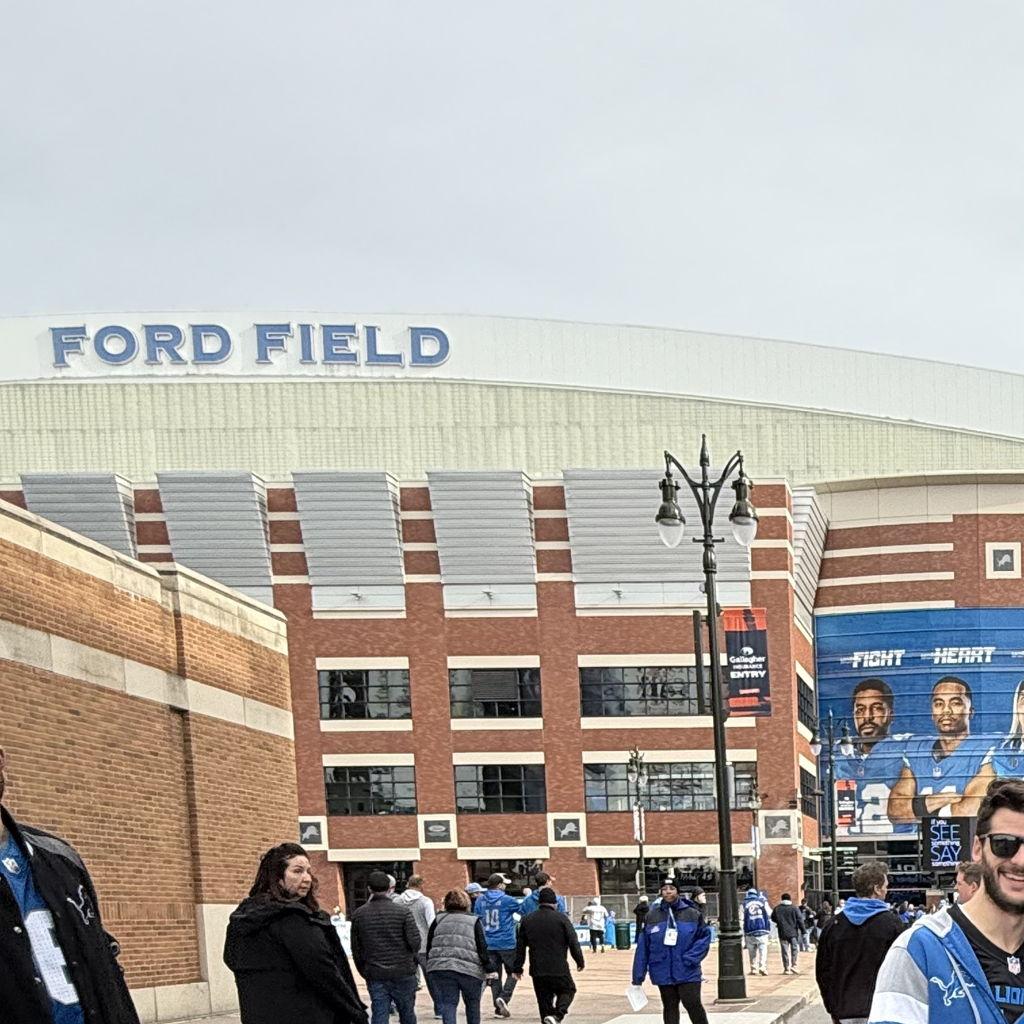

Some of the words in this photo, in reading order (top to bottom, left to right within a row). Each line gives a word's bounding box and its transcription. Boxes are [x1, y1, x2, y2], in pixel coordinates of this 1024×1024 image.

[50, 323, 232, 368] FORD
[254, 321, 451, 368] FIELD
[729, 655, 767, 664] Gallagher
[853, 650, 906, 668] FIGHT
[933, 646, 996, 664] HEART
[730, 670, 767, 678] ENTRY
[930, 824, 960, 841] SEE
[930, 846, 962, 862] SAY
